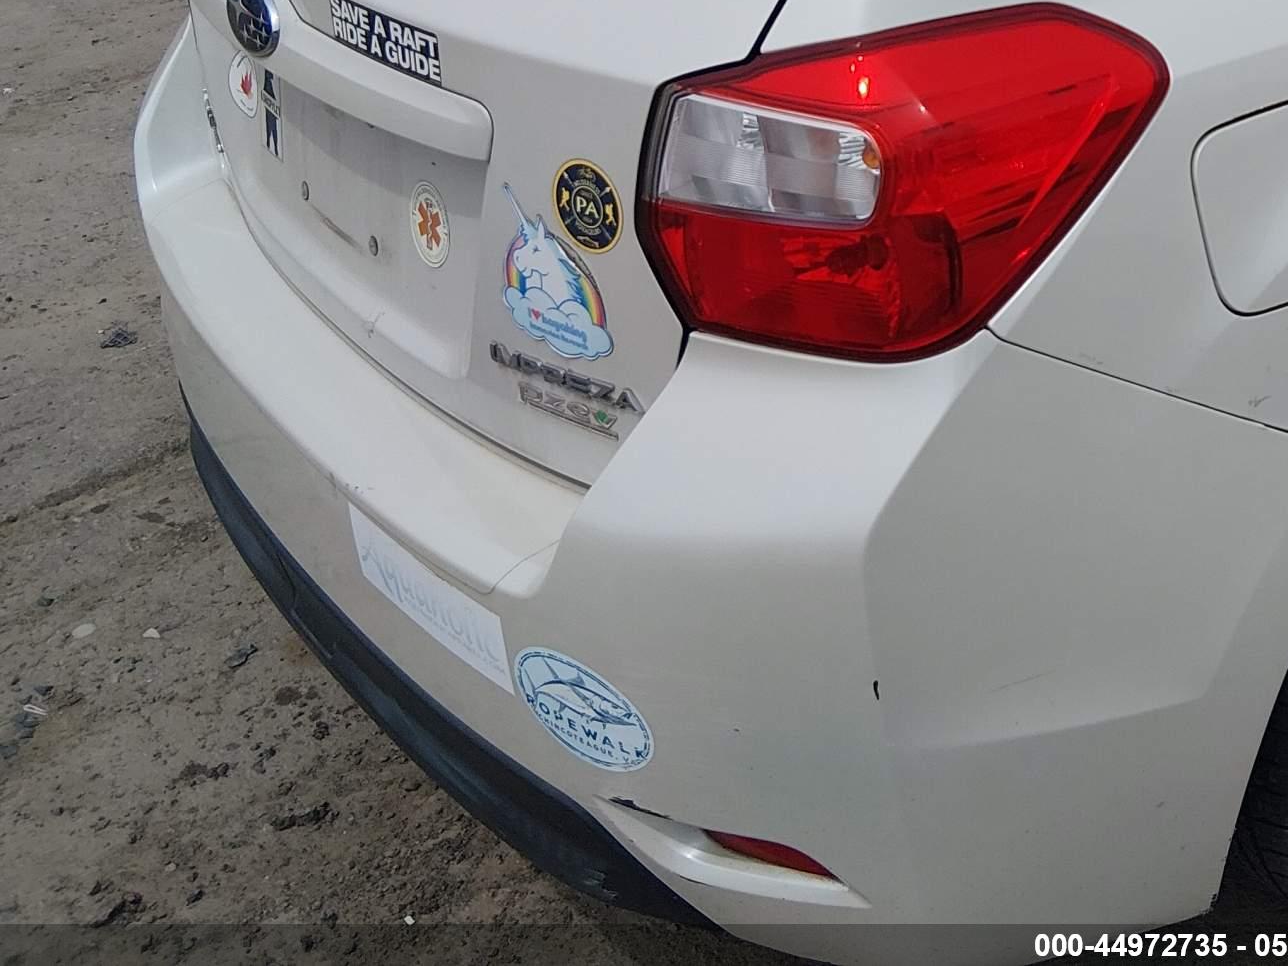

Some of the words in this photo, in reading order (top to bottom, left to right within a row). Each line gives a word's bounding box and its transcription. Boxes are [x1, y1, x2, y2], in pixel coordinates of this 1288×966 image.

[333, 16, 368, 51] RIDE
[371, 35, 382, 57] A
[385, 40, 441, 82] GUIDE
[374, 15, 386, 38] A
[388, 20, 438, 57] RAFT
[575, 196, 600, 219] PA
[490, 340, 645, 414] IMPREZA
